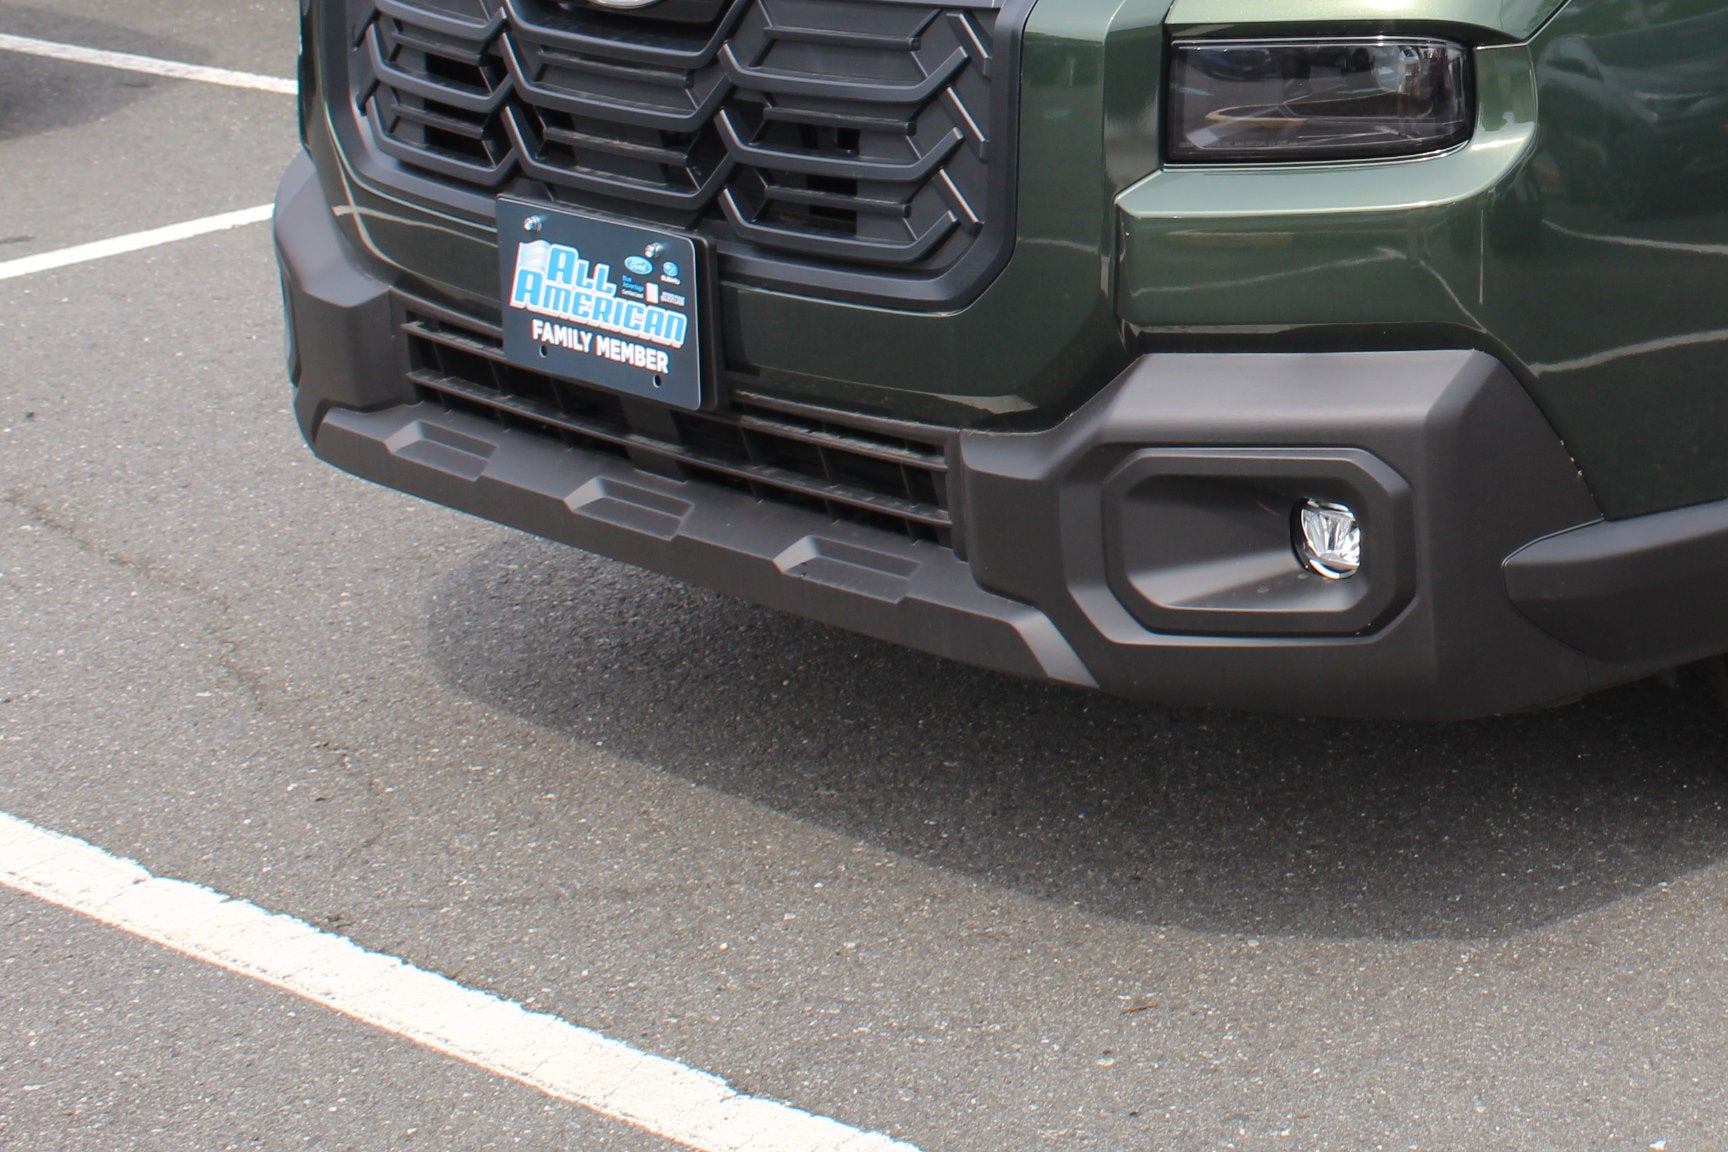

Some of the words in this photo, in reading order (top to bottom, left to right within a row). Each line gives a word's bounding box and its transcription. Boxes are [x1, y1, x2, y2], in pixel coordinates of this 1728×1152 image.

[549, 243, 617, 295] ALL
[510, 267, 688, 348] AMERICAN
[532, 319, 592, 353] FAMILY
[596, 335, 669, 374] MEMBER
